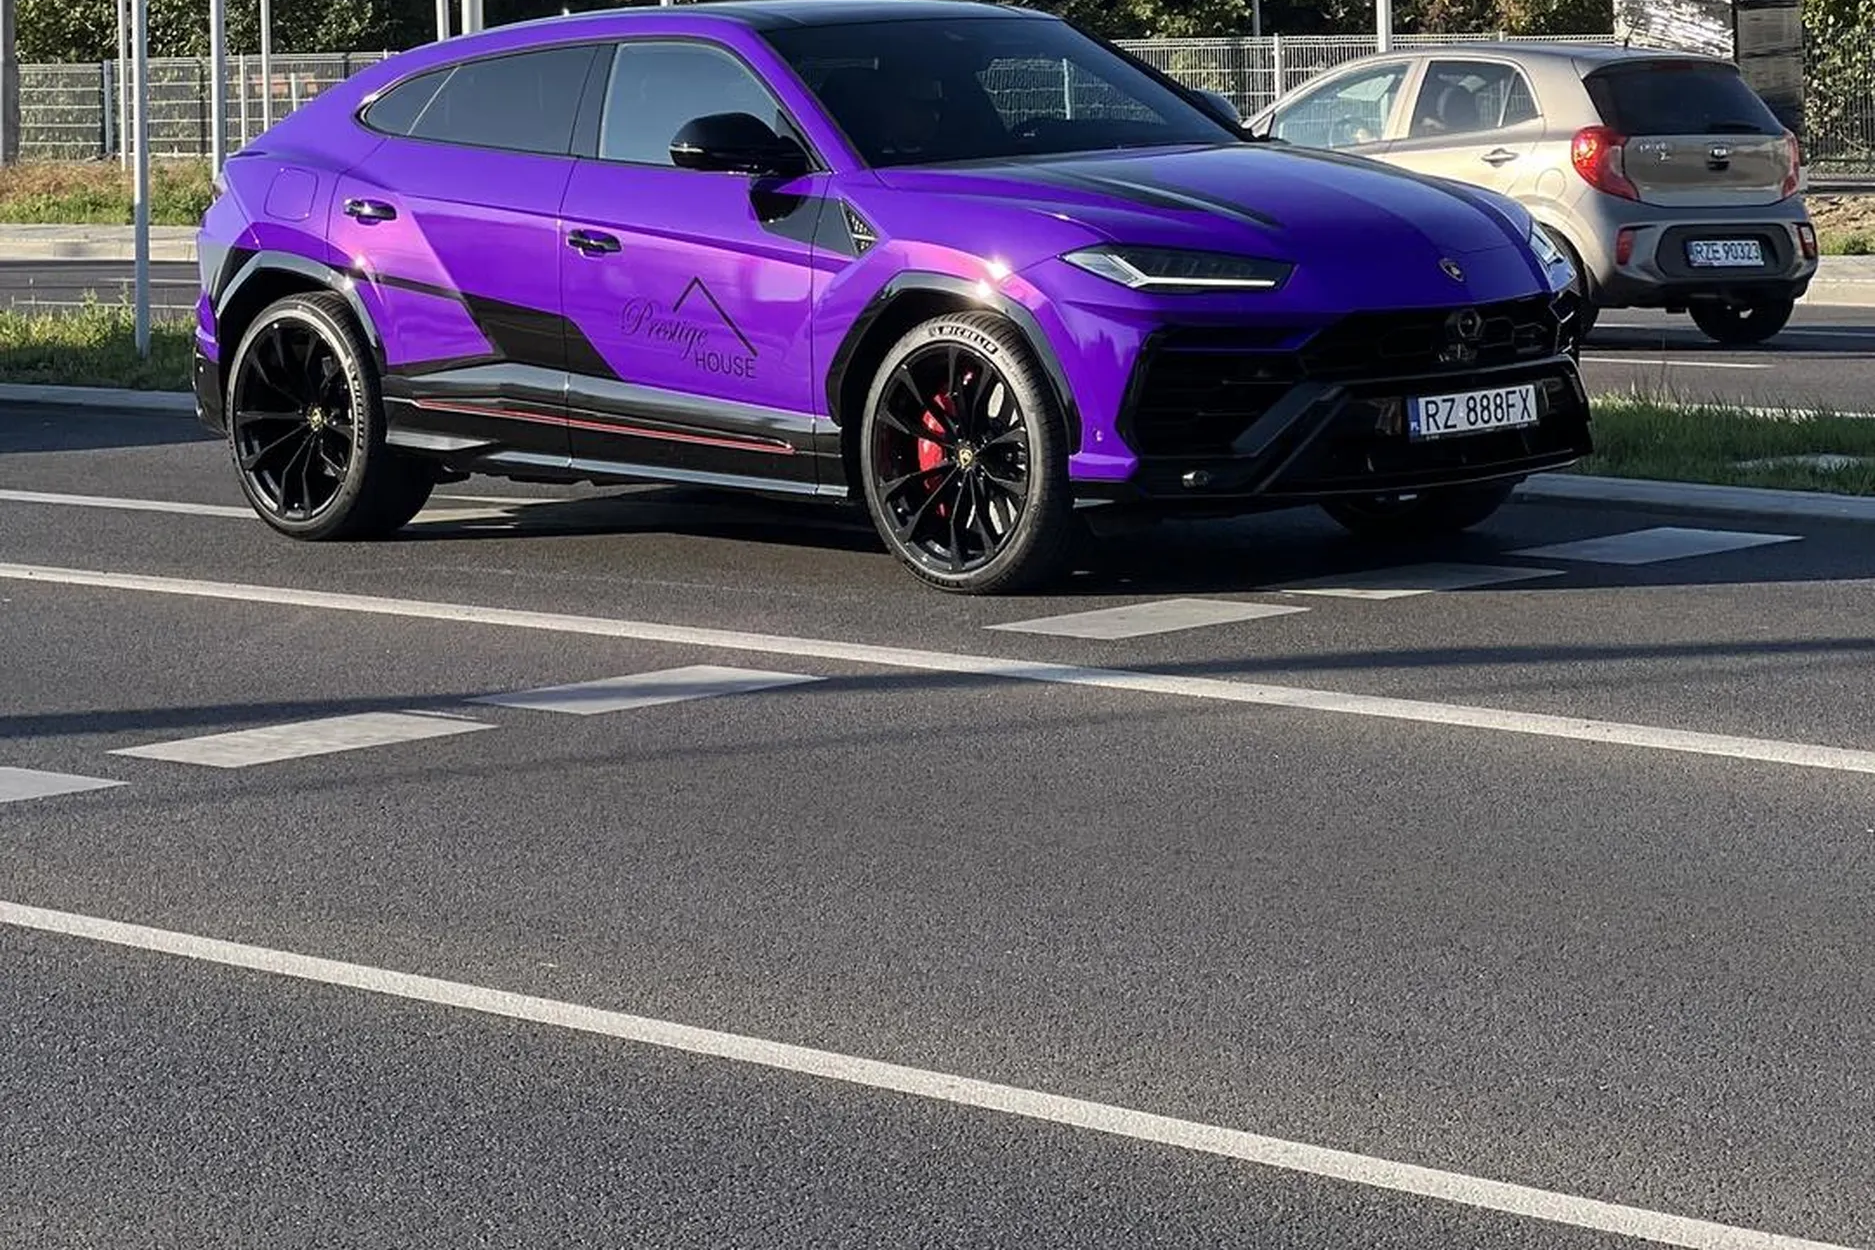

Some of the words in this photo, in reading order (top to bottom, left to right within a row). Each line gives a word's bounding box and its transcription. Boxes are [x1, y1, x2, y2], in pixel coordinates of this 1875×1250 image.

[1694, 242, 1720, 260] RZE
[621, 298, 708, 360] Prestige
[694, 351, 757, 378] HOUSE
[1425, 398, 1457, 431] RZ
[1466, 388, 1531, 426] 888FX
